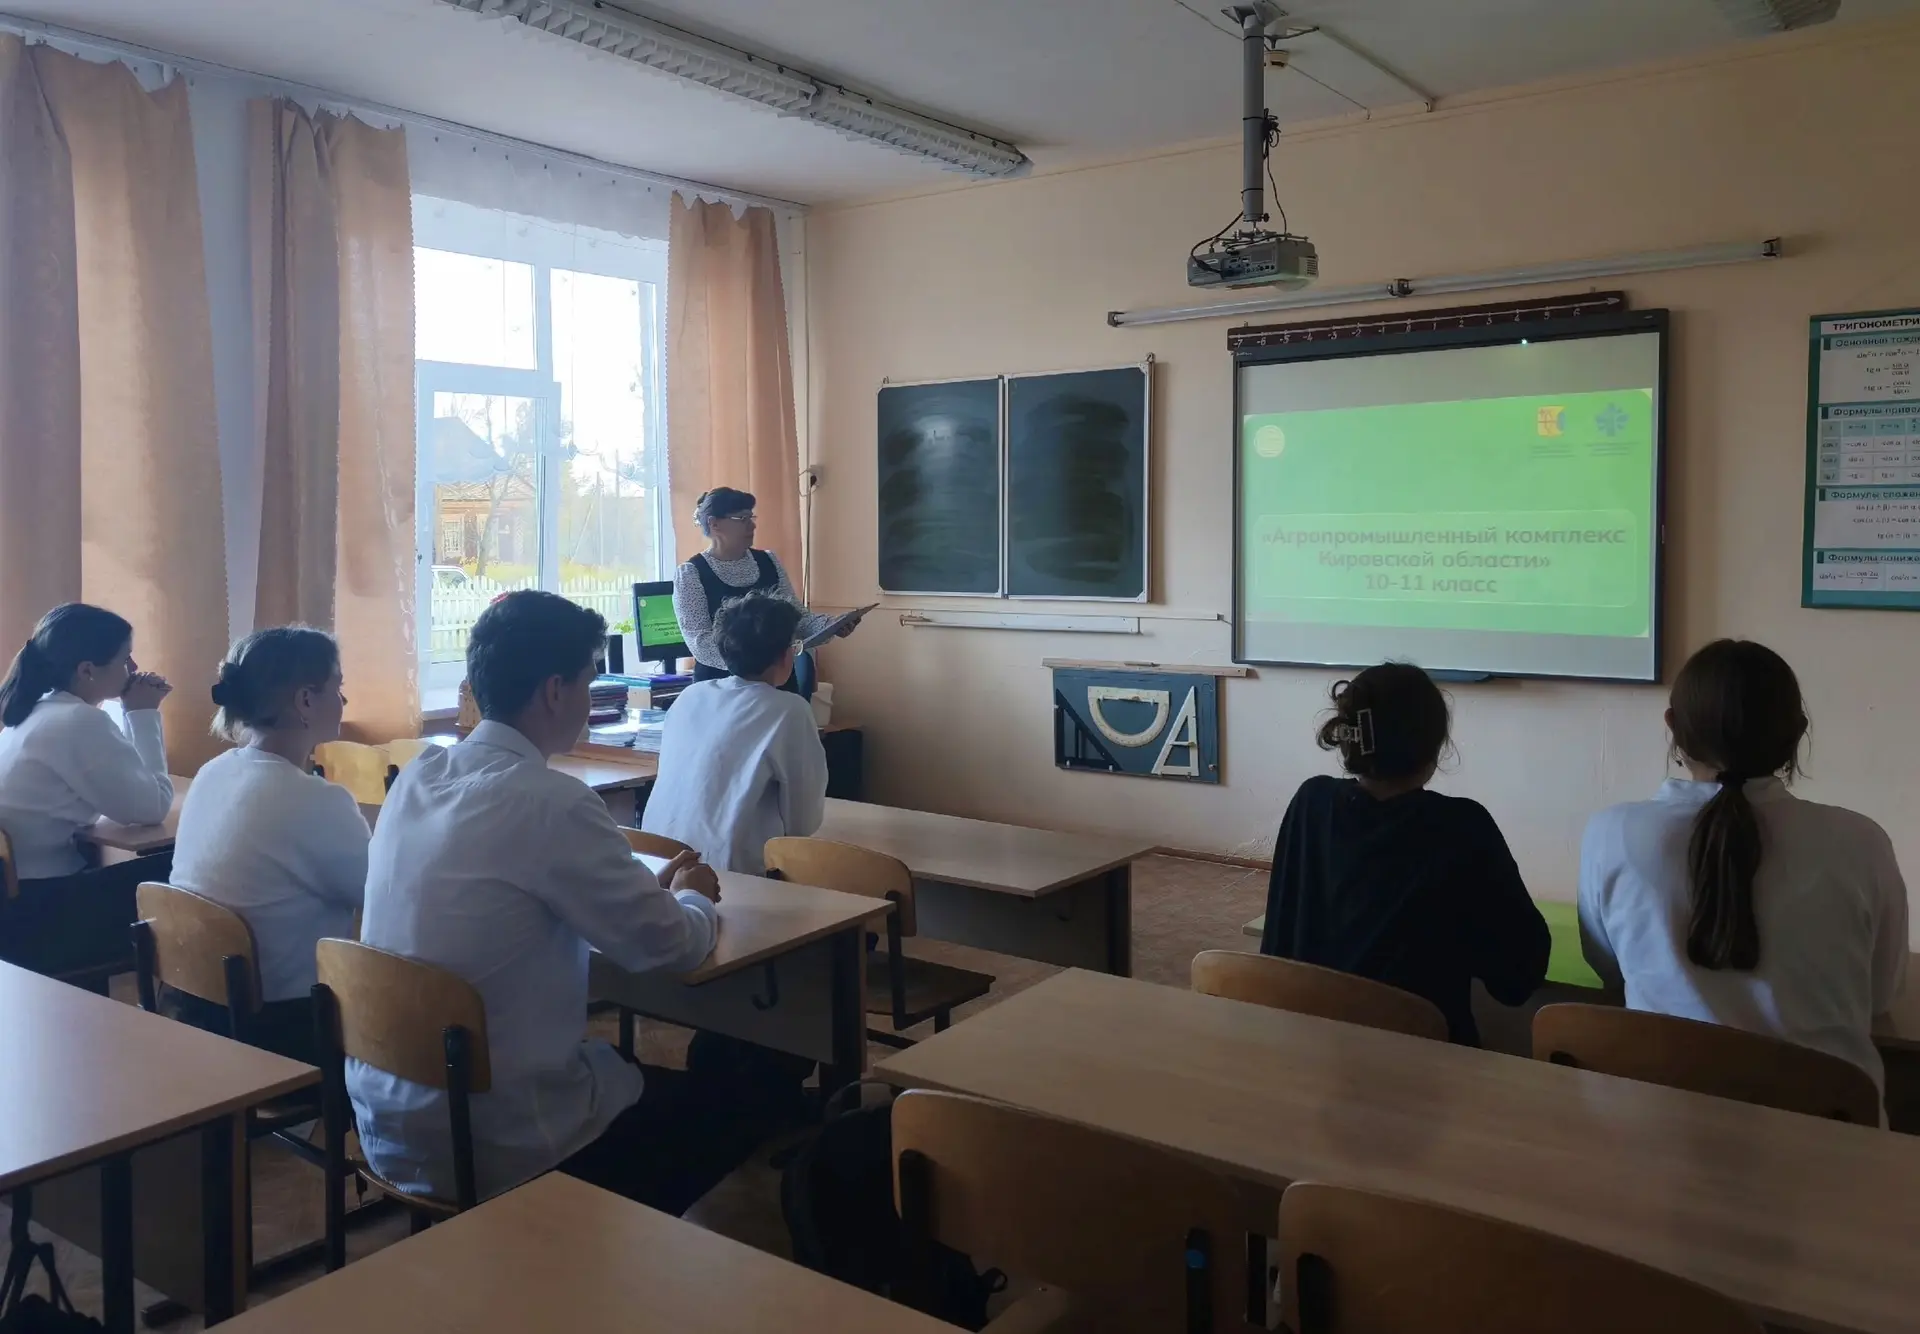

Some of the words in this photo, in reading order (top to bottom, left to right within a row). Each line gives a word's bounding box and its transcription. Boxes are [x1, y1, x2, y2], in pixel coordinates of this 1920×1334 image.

[1233, 338, 1244, 348] -7
[1256, 337, 1267, 346] -6
[1279, 335, 1290, 344] -5
[1302, 333, 1314, 342] -4
[1327, 331, 1338, 340] -3
[1351, 329, 1362, 337] -2
[1378, 326, 1386, 334] -1
[1404, 324, 1412, 333] 0
[1432, 322, 1438, 331] 1
[1458, 319, 1465, 328] 2
[1486, 317, 1493, 325] 3
[1830, 491, 1880, 500] Формулы
[1262, 526, 1498, 548] «Агропромышленный
[1505, 529, 1627, 544] комплекс
[1318, 551, 1435, 571] Кировской
[1442, 551, 1551, 568] области»
[1828, 554, 1878, 563] Формулы
[1365, 574, 1426, 591] 10-11
[1432, 579, 1498, 593] класс
